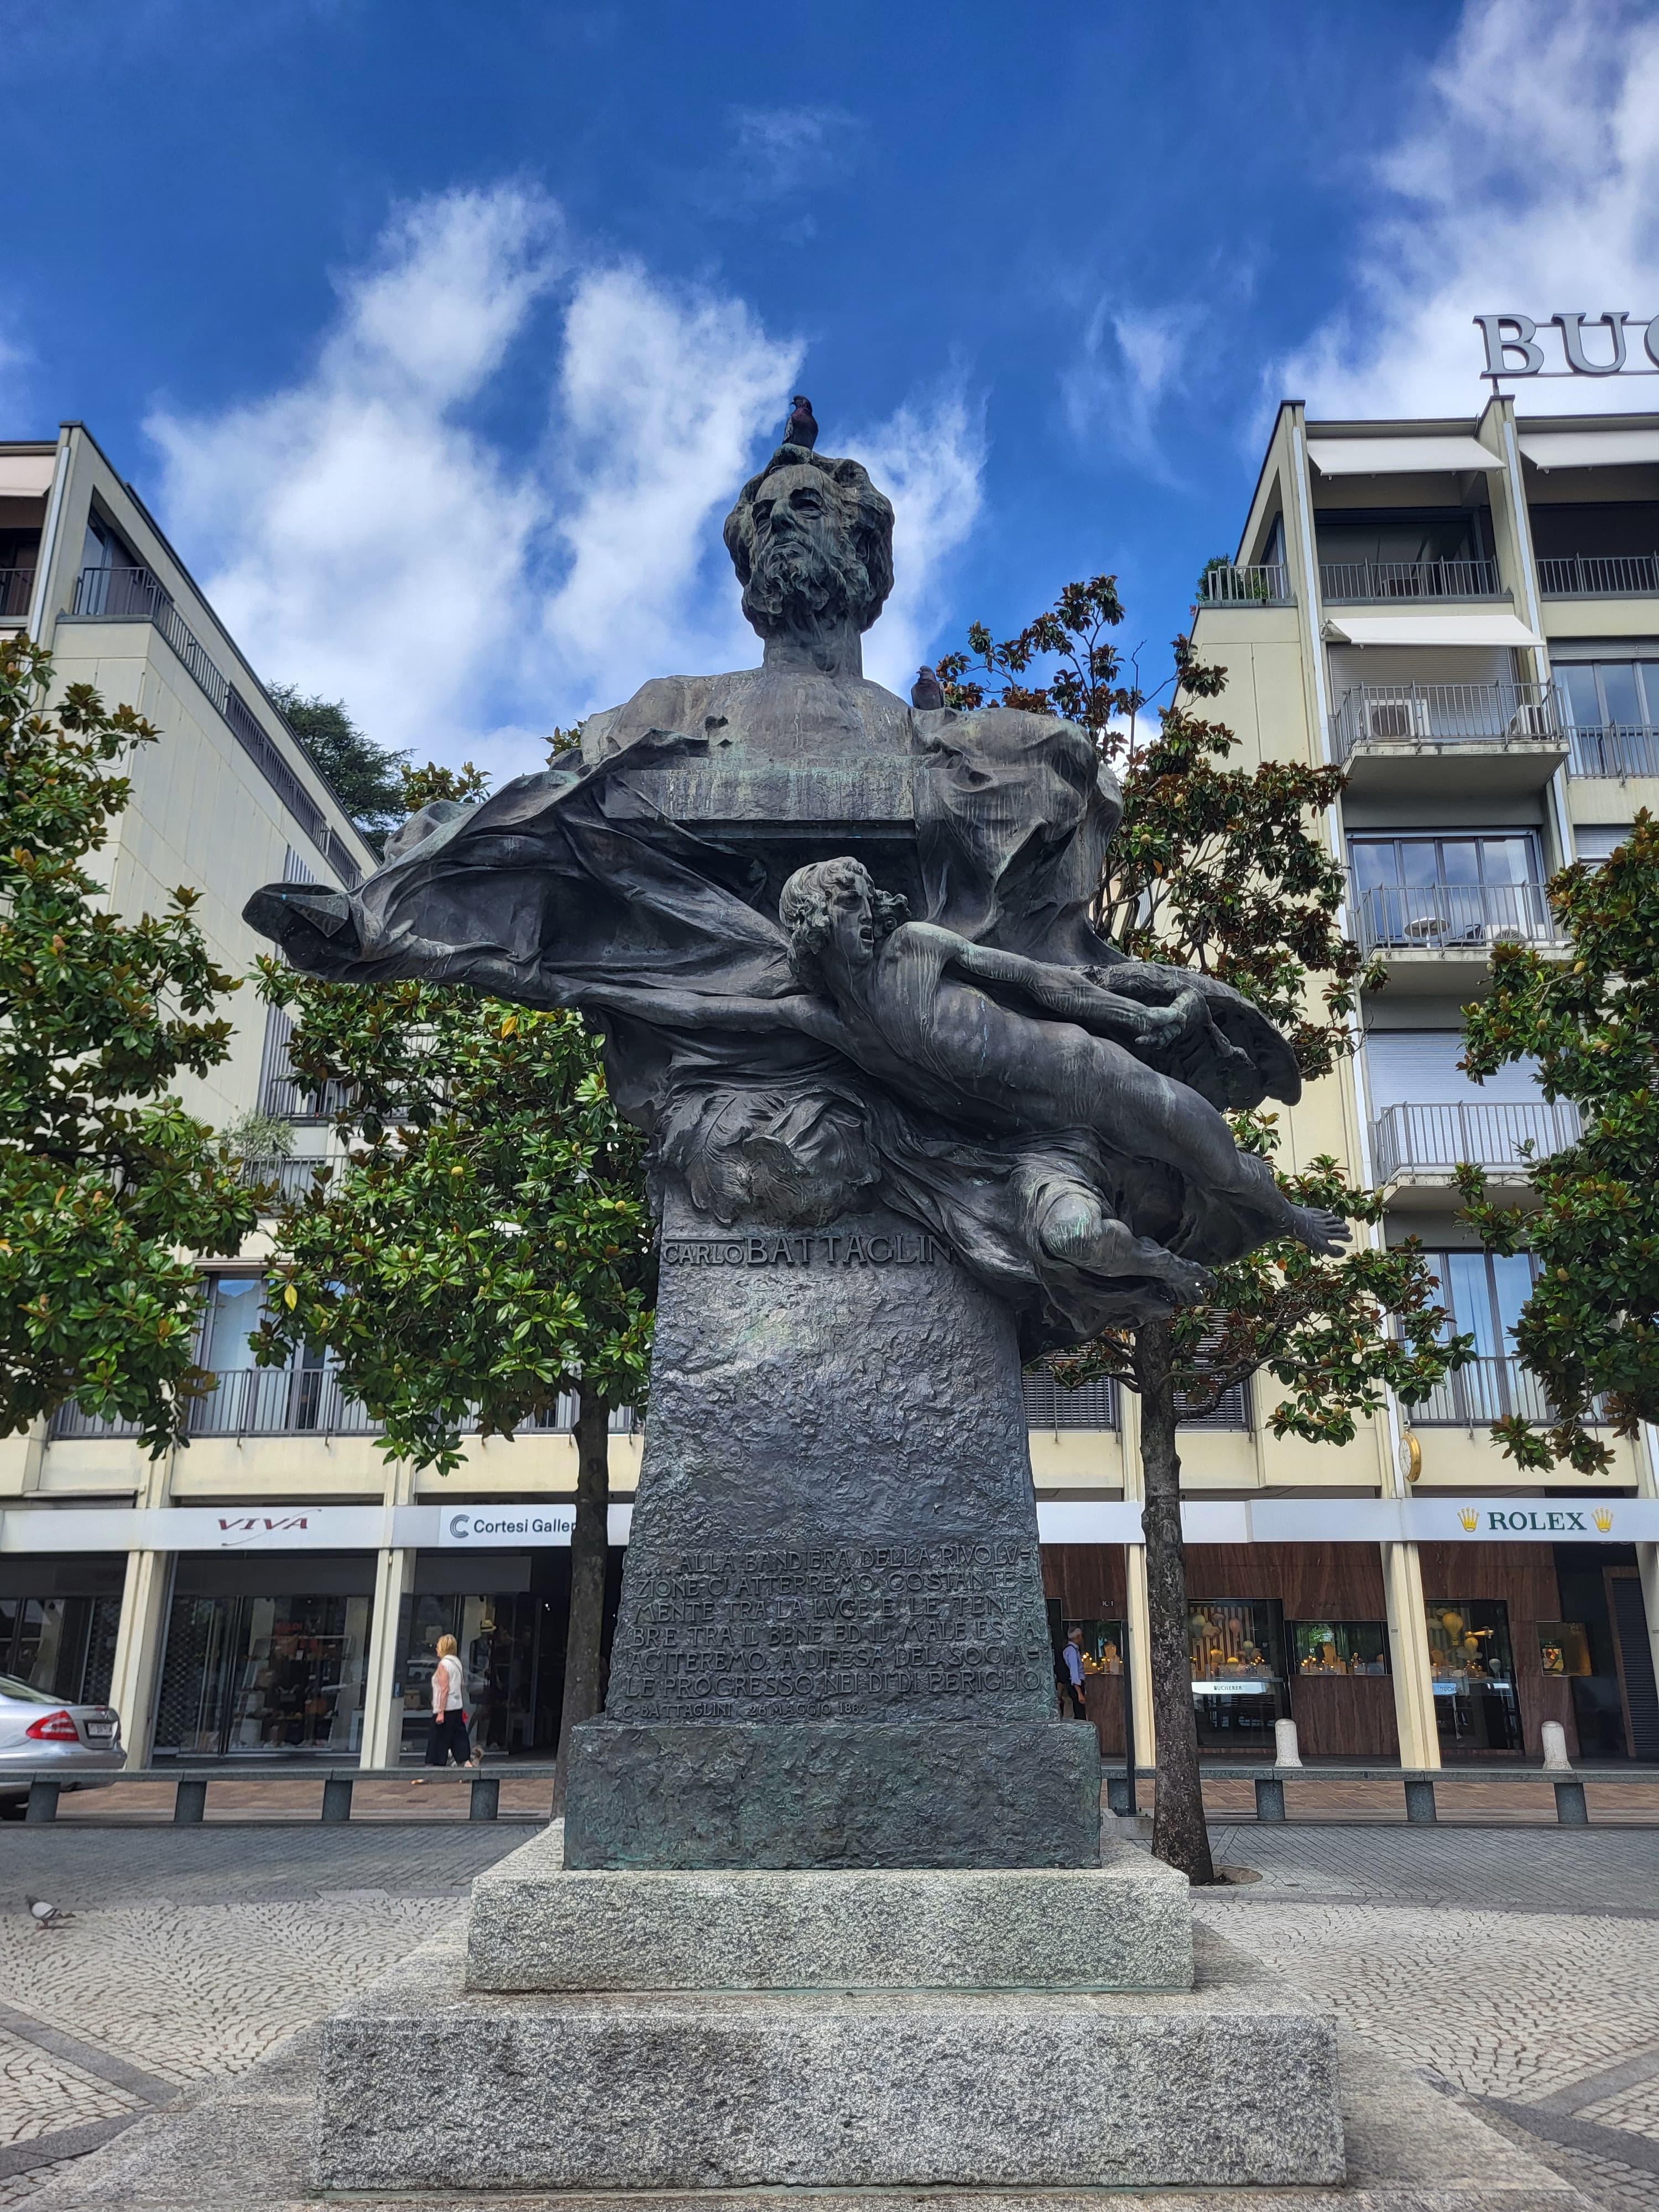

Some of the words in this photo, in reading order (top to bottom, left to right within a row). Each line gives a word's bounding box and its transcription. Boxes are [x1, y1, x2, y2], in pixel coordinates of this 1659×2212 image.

[664, 1243, 745, 1265] CARLO
[217, 1517, 308, 1530] VIVA
[473, 1519, 528, 1533] Cortesi
[1486, 1511, 1588, 1531] ROLEX
[744, 1549, 851, 1573] BANDIERA
[858, 1547, 932, 1569] DELLA
[636, 1578, 700, 1599] ZIONE
[708, 1577, 731, 1597] CI
[736, 1573, 874, 1596] ATTERREMO
[636, 1601, 715, 1623] MENTE
[724, 1600, 768, 1621] TRA
[775, 1599, 806, 1619] LA
[881, 1597, 895, 1617] E
[909, 1597, 940, 1616] LE
[630, 1627, 678, 1648] BRE
[688, 1626, 734, 1647] TRA
[742, 1625, 760, 1647] IL
[767, 1625, 824, 1647] BENE
[833, 1624, 862, 1644] ED
[872, 1621, 889, 1642] IL
[900, 1620, 968, 1642] MALE
[975, 1619, 1039, 1640] ESSA
[780, 1650, 797, 1670] A
[805, 1647, 885, 1668] DIFESA
[894, 1646, 940, 1668] DEL
[624, 1677, 655, 1697] LE
[663, 1674, 814, 1698] PROGRESSO
[823, 1672, 858, 1694] NEI
[928, 1670, 1041, 1692] PERIGLIO
[640, 1703, 733, 1718] BATTAGLINI
[749, 1705, 766, 1715] 26
[771, 1703, 831, 1715] MAGGIO
[838, 1703, 868, 1714] 1862
